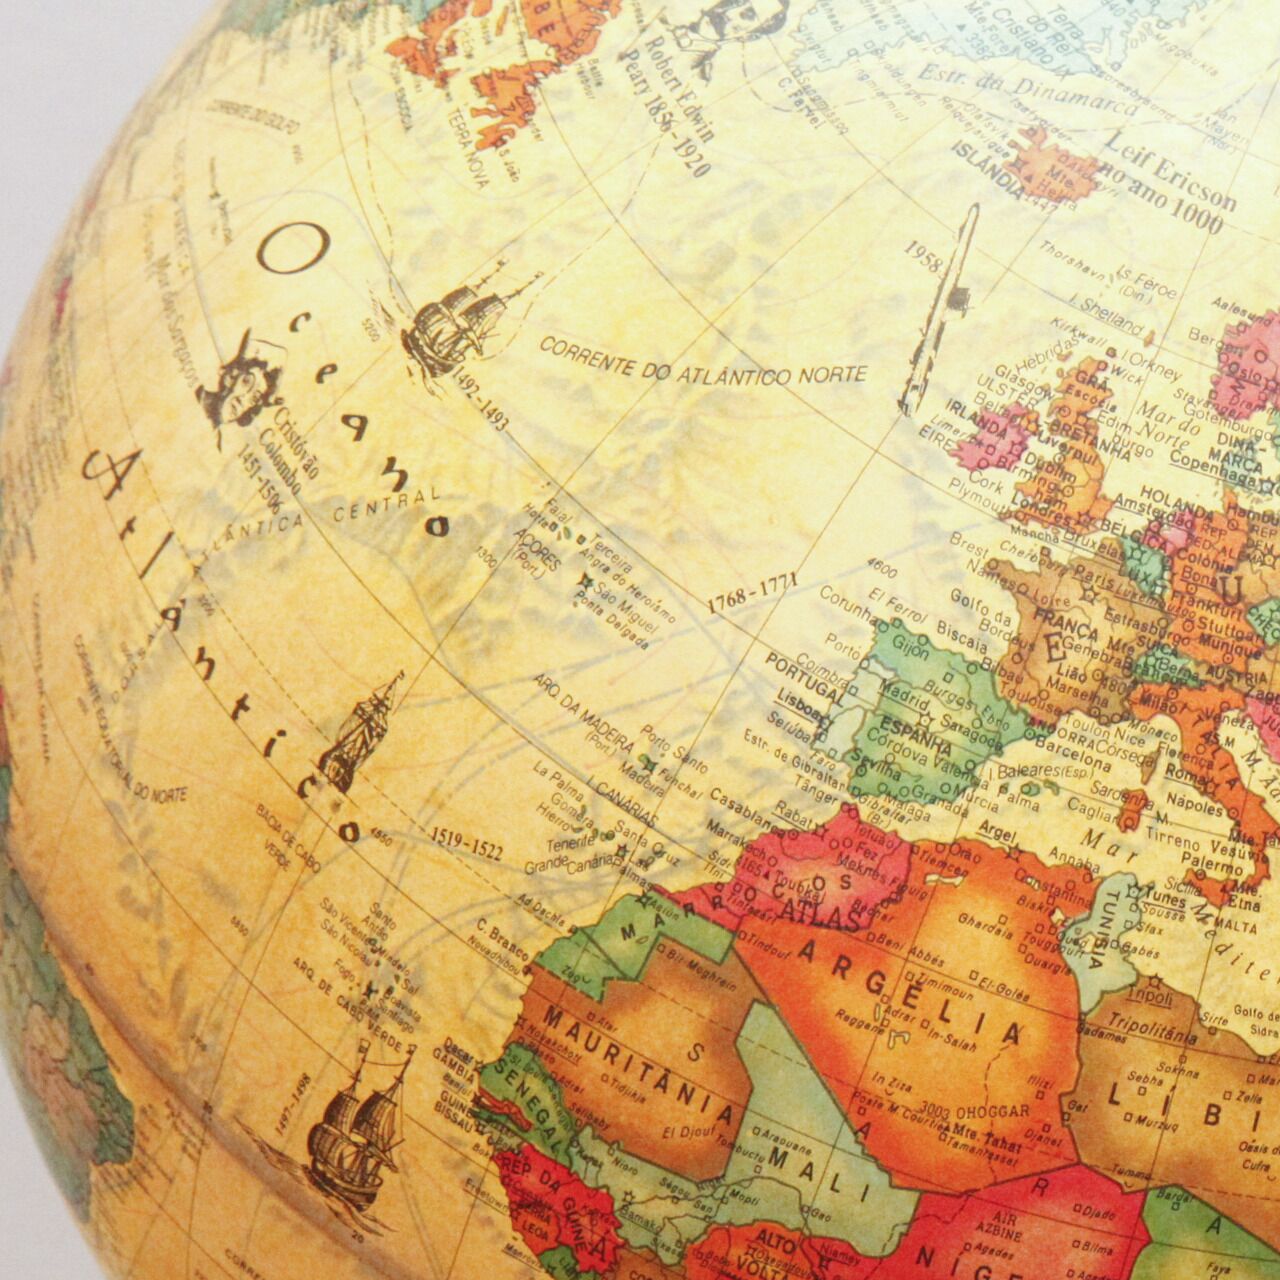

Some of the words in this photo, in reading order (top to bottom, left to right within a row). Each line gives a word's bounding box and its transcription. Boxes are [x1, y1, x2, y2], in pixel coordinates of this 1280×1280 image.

[624, 48, 652, 99] Peary
[645, 36, 680, 103] Robert
[677, 92, 715, 146] Edwin
[1012, 75, 1139, 119] Dinamarca
[1105, 130, 1143, 167] Leif
[1151, 156, 1238, 214] Ericson
[1097, 160, 1125, 183] no
[1126, 170, 1163, 204] ano
[1168, 199, 1224, 236] 1000
[904, 240, 944, 275] 1958
[539, 335, 635, 378] CORRENTE
[641, 364, 671, 382] DO
[679, 364, 790, 386] ATLÂNTICO
[800, 364, 868, 384] NORTE
[450, 365, 510, 432] 1492-1493
[1138, 401, 1172, 427] Mar
[1176, 418, 1202, 437] do
[273, 406, 320, 483] Cristóvão
[1136, 422, 1191, 452] Norte
[257, 427, 303, 497] Colombo
[1170, 448, 1258, 490] Copenhaga
[512, 527, 562, 573] AÇORES
[706, 570, 800, 615] 1768-1771
[1033, 608, 1099, 643] FRANÇA
[764, 652, 845, 708] PORTUGAL
[878, 678, 931, 713] Madrid
[776, 686, 826, 730] Lisboa
[879, 715, 954, 758] ESPANHA
[1035, 734, 1113, 773] Barcelona
[1165, 789, 1224, 817] Nápoles
[429, 826, 504, 862] 1519-1522
[778, 899, 859, 933] ATLAS
[1214, 916, 1257, 936] MALTA
[796, 938, 1021, 1046] ARGÉLIA
[494, 1058, 563, 1156] SENEGAL
[767, 1145, 870, 1204] MALI
[754, 1228, 796, 1254] ALTO
